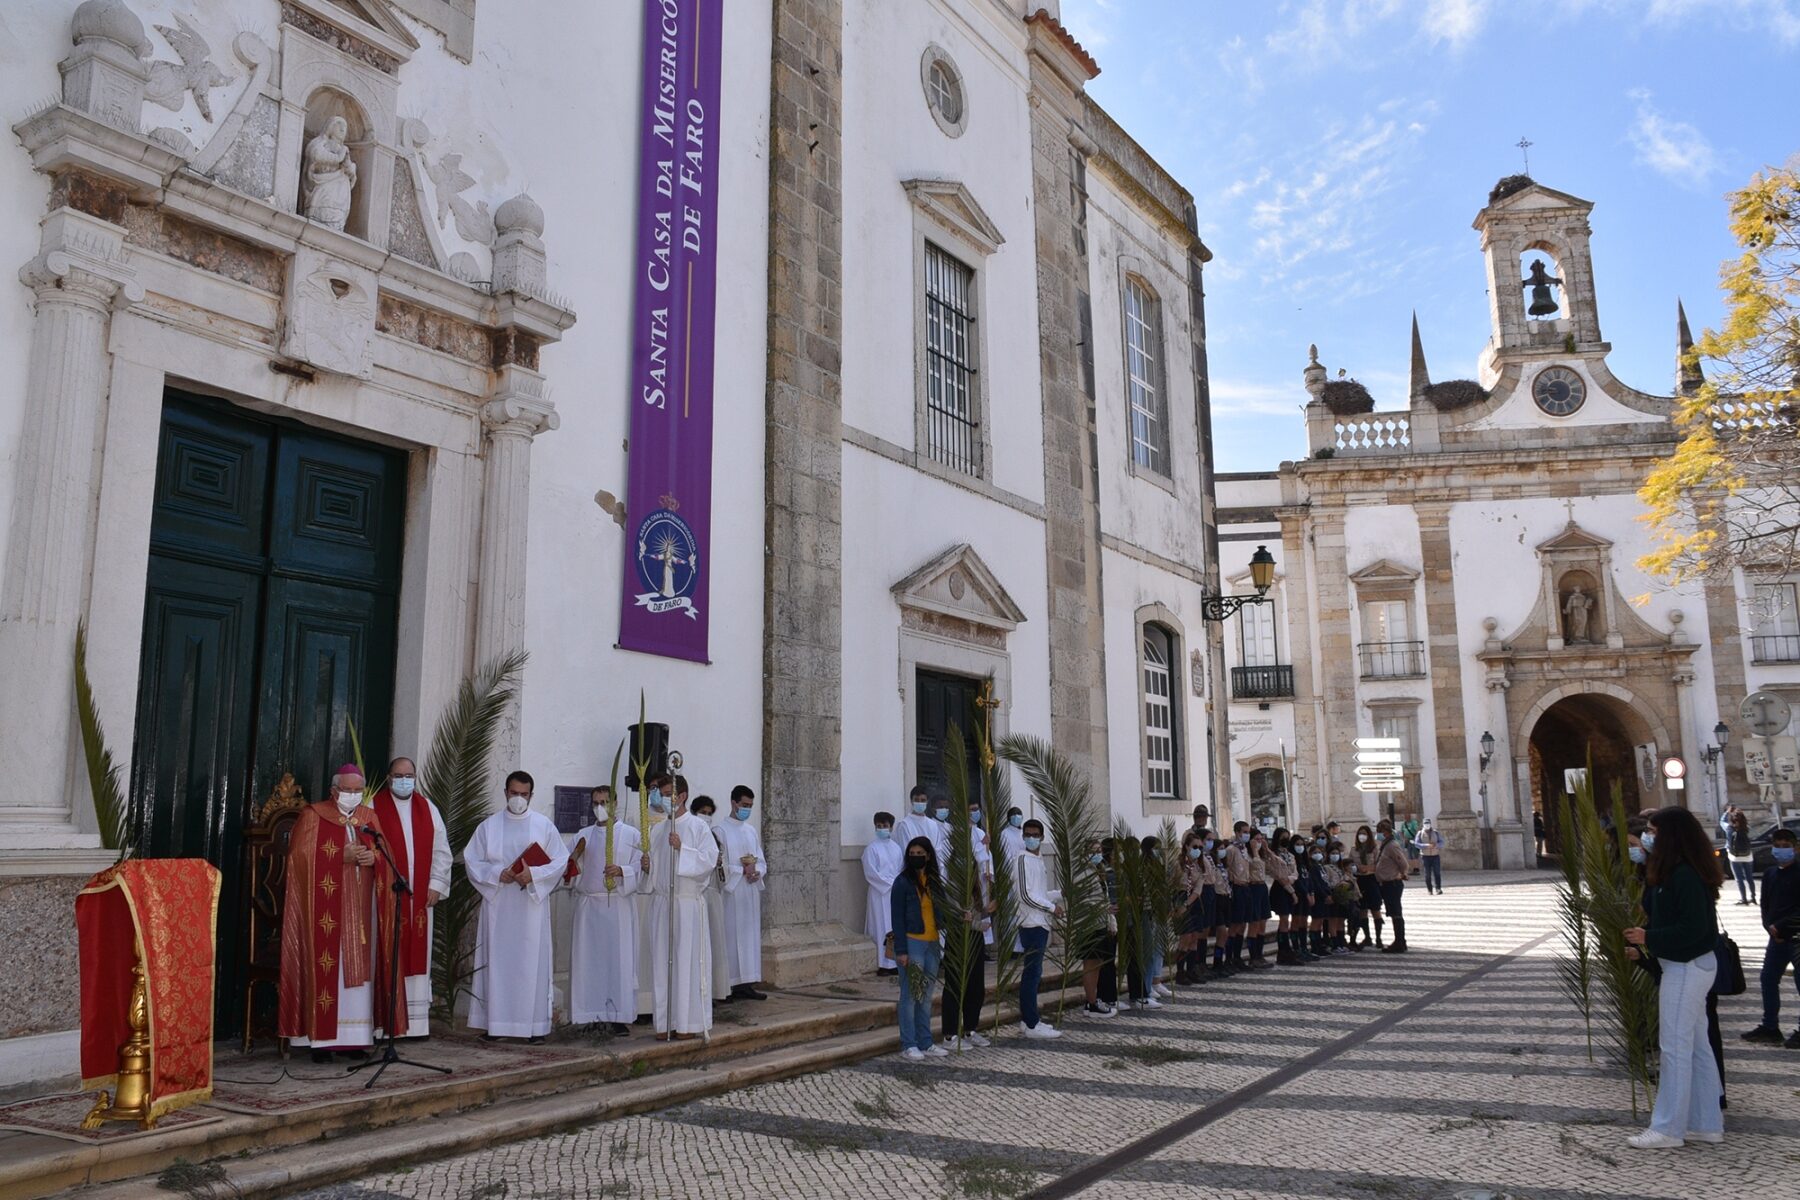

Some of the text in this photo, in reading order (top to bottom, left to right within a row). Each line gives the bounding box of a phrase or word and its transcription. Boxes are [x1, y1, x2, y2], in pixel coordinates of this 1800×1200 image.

[656, 160, 673, 199] DA
[680, 99, 704, 255] DE FARO
[647, 210, 672, 291] CASA
[643, 307, 669, 410] SANTA
[653, 598, 682, 612] DE FARO
